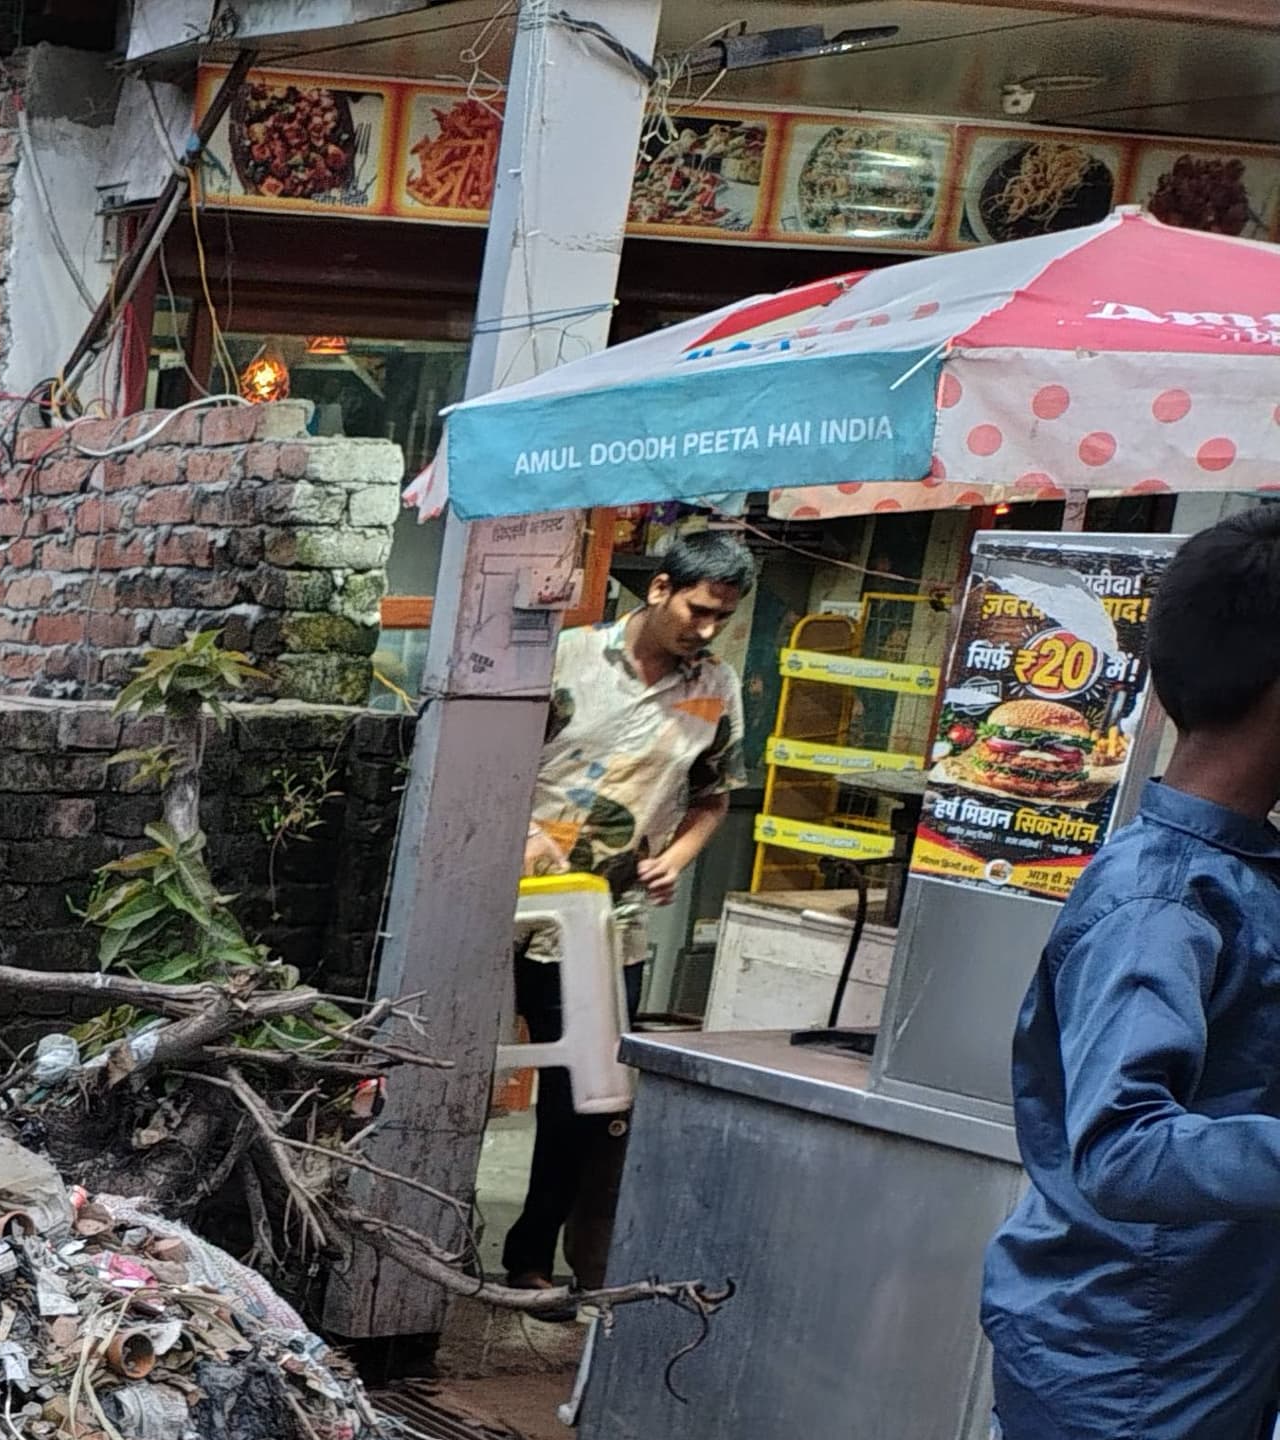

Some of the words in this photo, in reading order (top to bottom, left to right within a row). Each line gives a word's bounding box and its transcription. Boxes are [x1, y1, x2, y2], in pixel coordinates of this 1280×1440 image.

[514, 445, 582, 476] AMUL
[589, 435, 677, 467] DOODH
[683, 425, 760, 457] PEETA
[766, 422, 811, 449] HAI
[819, 414, 893, 445] INDIA
[1014, 637, 1095, 691] ₹20
